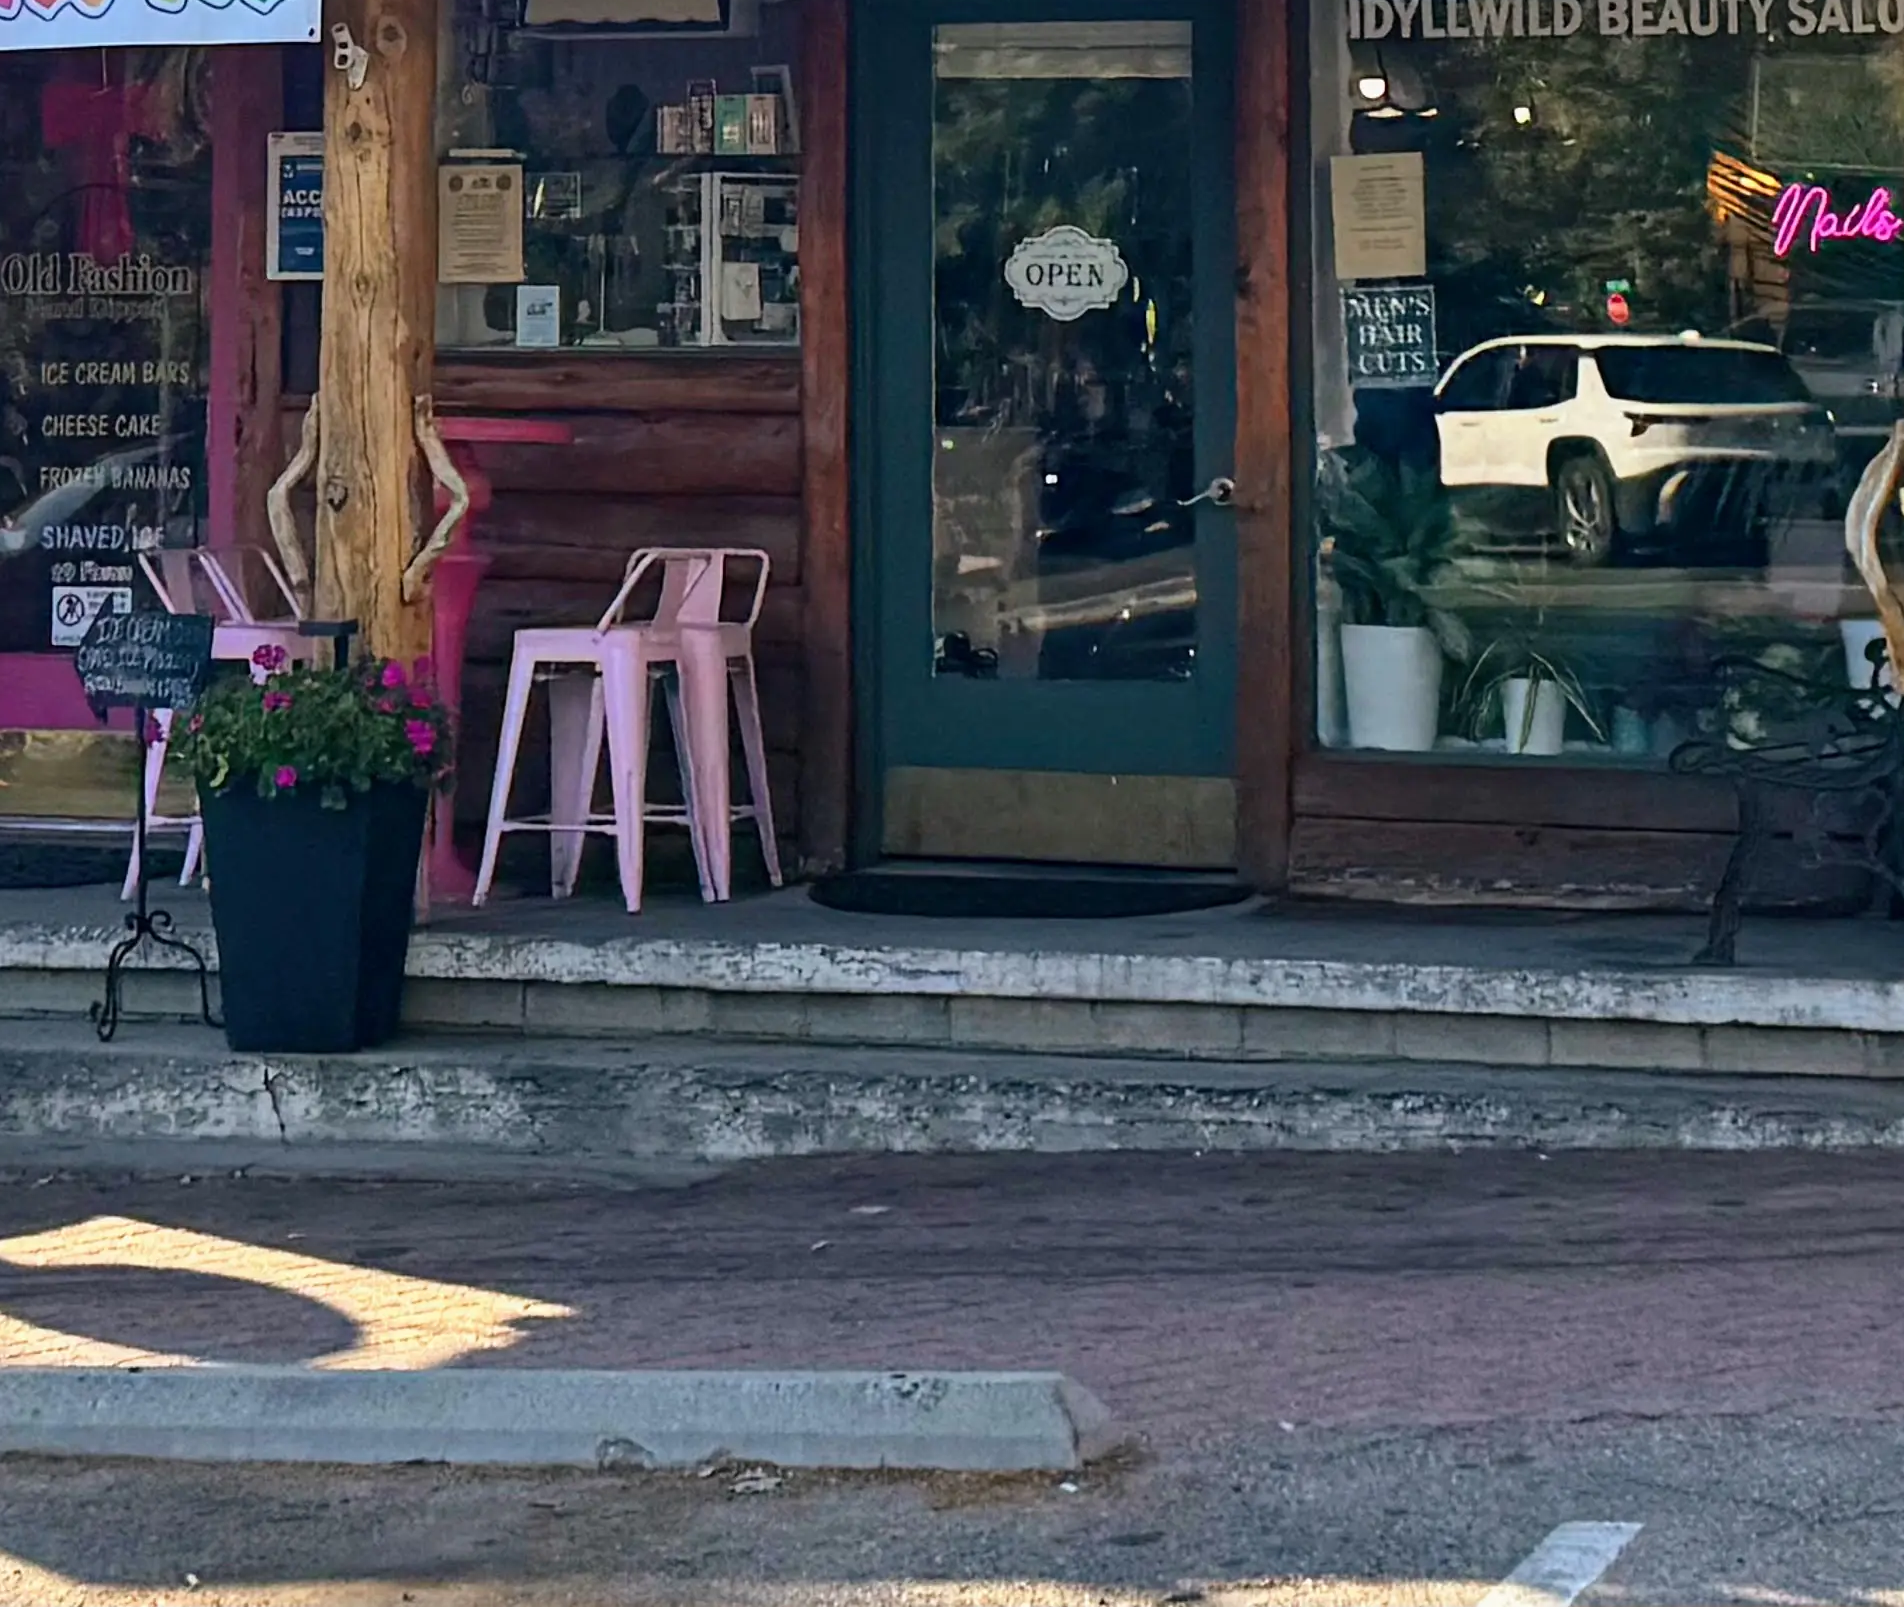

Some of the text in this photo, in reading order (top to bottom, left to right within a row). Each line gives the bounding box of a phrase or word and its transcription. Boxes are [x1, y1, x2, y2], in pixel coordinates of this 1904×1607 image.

[1772, 183, 1903, 257] Nails
[0, 252, 192, 295] Old Fashion
[1026, 263, 1104, 287] OPEN
[1349, 295, 1431, 323] MEN'S
[1359, 323, 1423, 346] HAIR
[41, 362, 190, 385] ICE CREAM BARS
[1359, 351, 1425, 375] CUTS
[42, 414, 161, 437] CHEESE CAKE
[40, 466, 191, 489] FROZEN BANANAS
[42, 525, 124, 549] SHAVED
